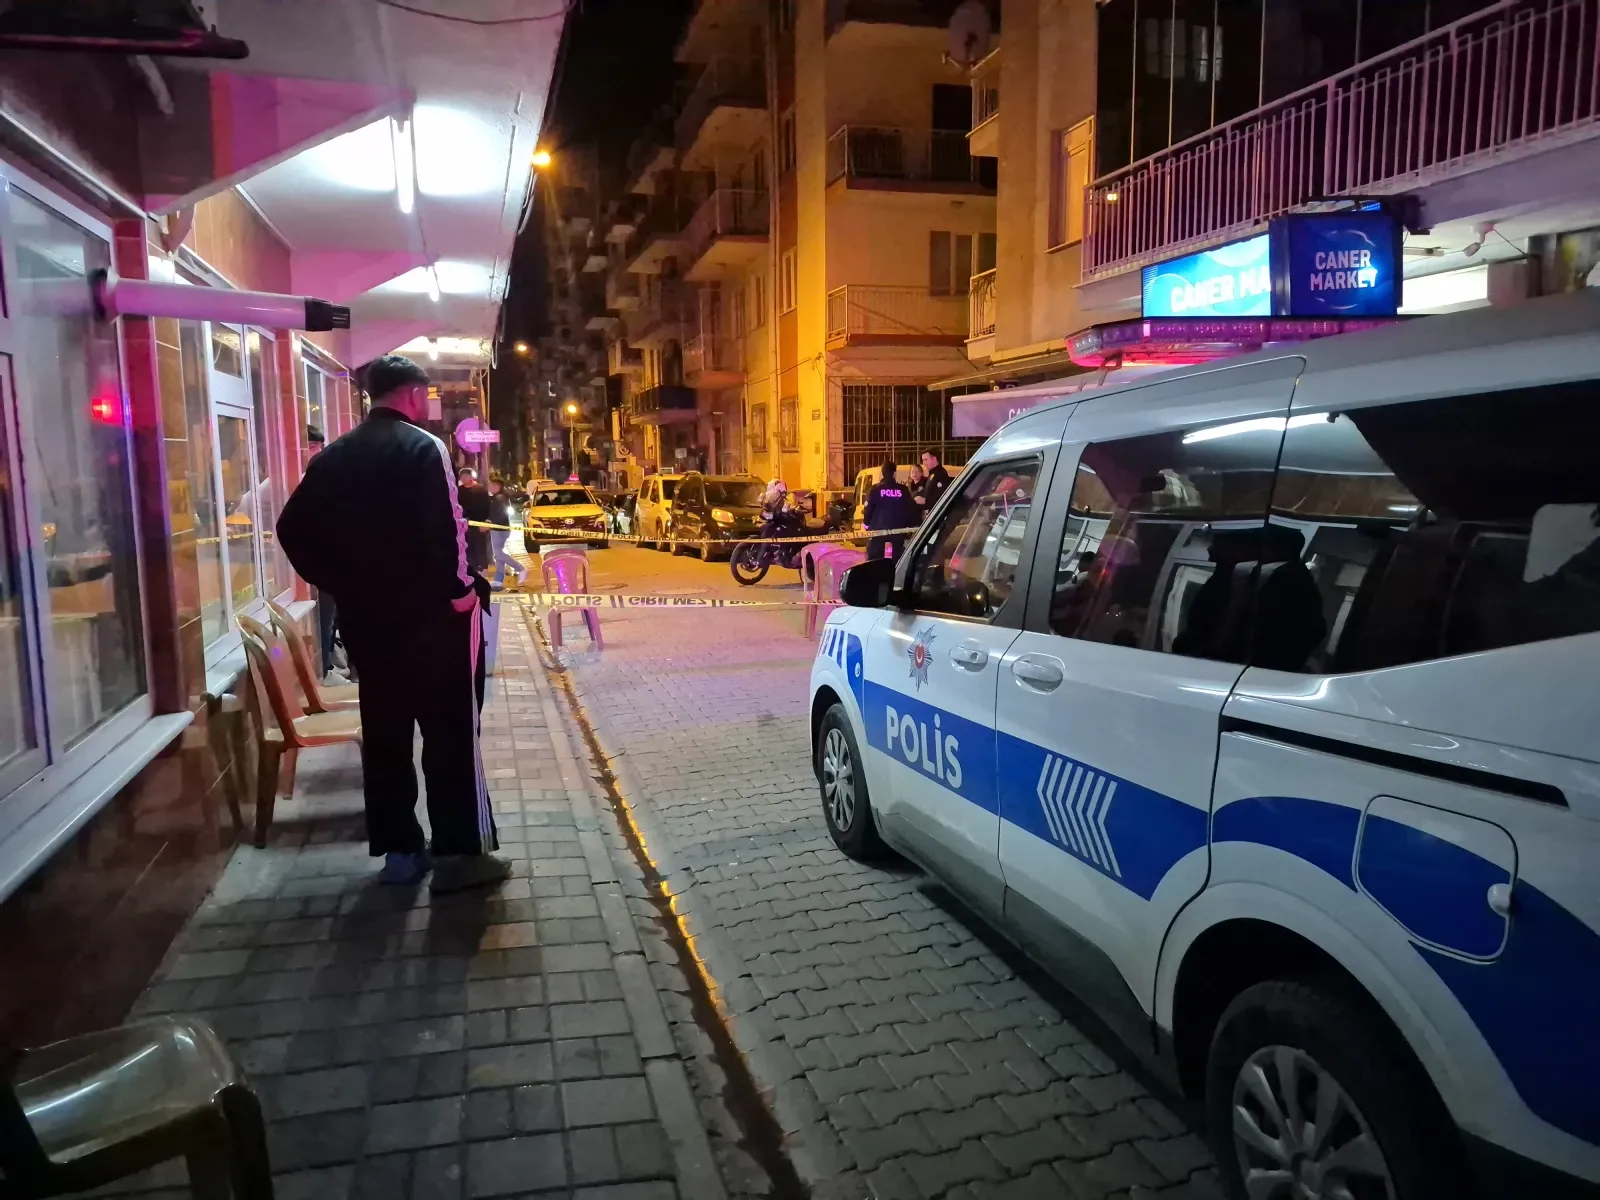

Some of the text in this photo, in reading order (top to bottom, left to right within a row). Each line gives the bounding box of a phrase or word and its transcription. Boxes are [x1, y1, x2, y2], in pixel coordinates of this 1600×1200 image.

[1315, 249, 1371, 270] CANER
[1310, 267, 1378, 291] MARKET
[1171, 278, 1235, 313] CANER
